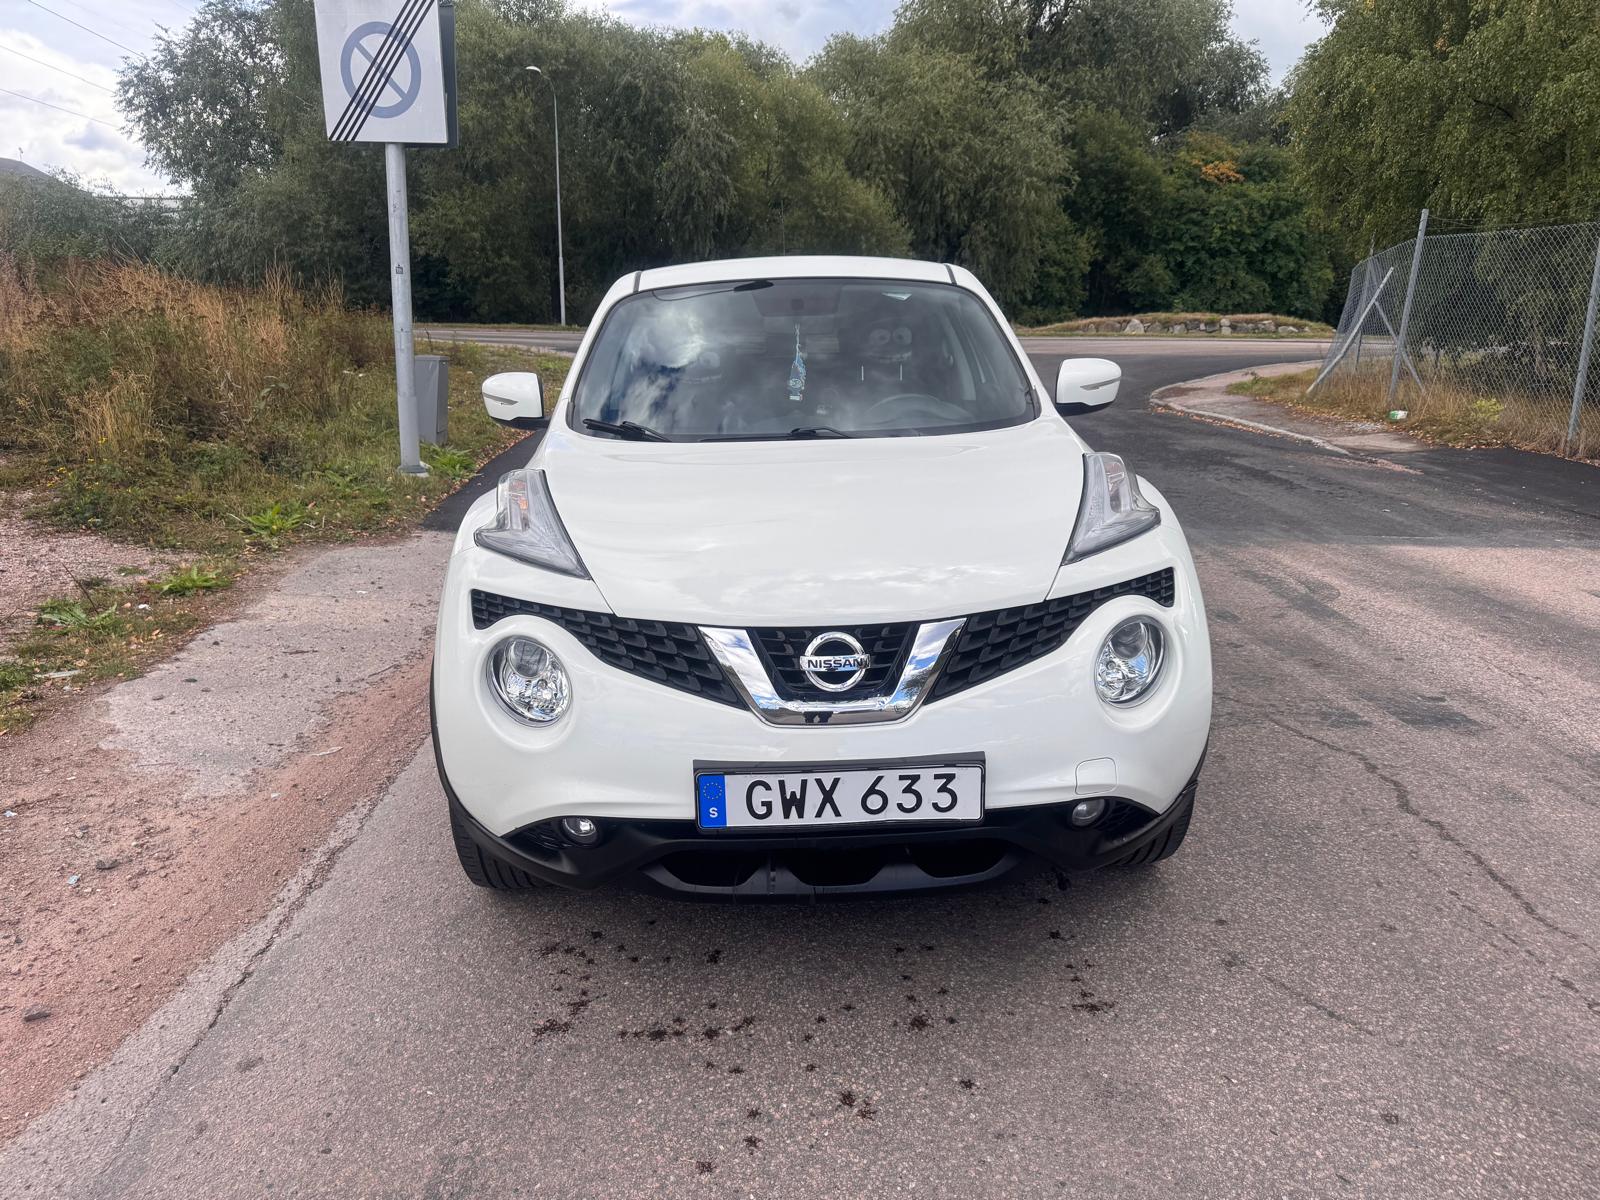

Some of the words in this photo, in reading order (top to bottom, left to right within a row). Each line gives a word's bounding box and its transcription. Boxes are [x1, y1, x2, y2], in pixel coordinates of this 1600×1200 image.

[807, 659, 864, 669] NISSAN
[745, 777, 842, 820] GWX
[860, 773, 958, 815] 633
[709, 806, 718, 818] S
